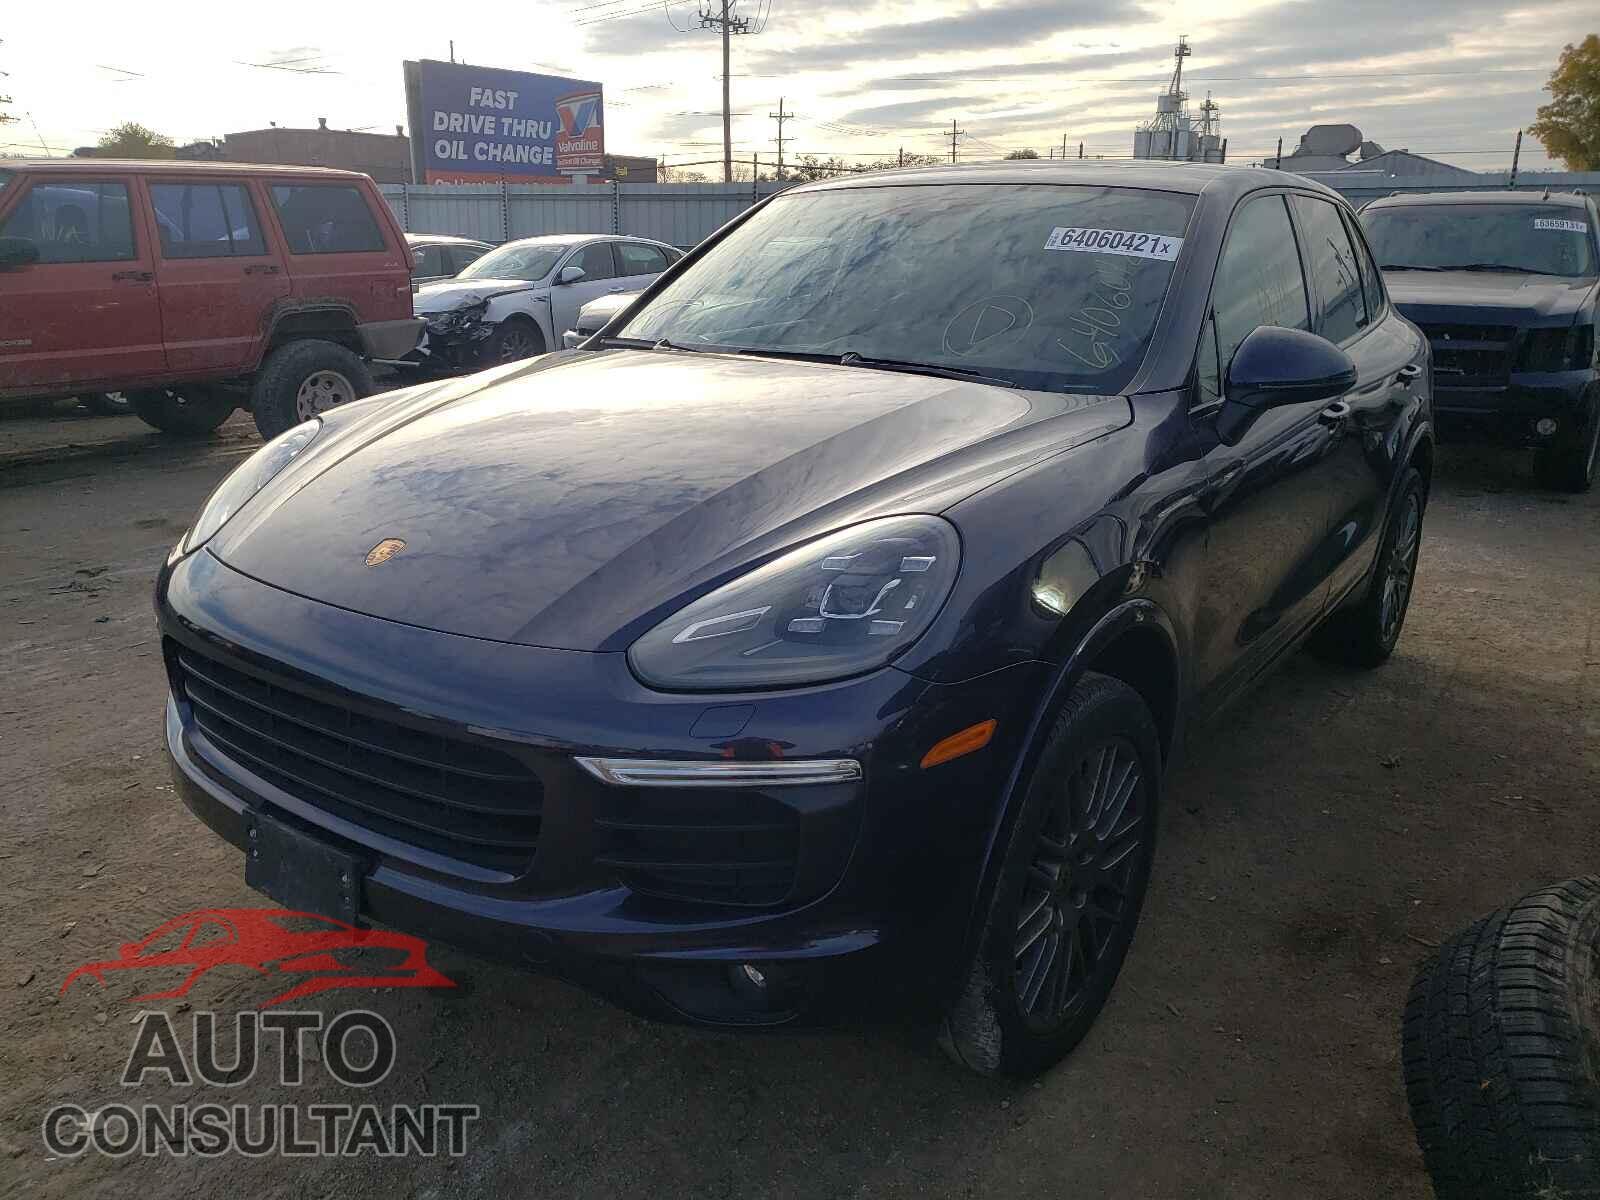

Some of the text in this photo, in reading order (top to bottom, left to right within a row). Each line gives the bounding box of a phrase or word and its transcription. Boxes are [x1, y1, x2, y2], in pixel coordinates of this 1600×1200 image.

[470, 87, 518, 109] FAST
[433, 111, 551, 139] DRIVE THRU
[434, 140, 554, 165] OIL CHANGE
